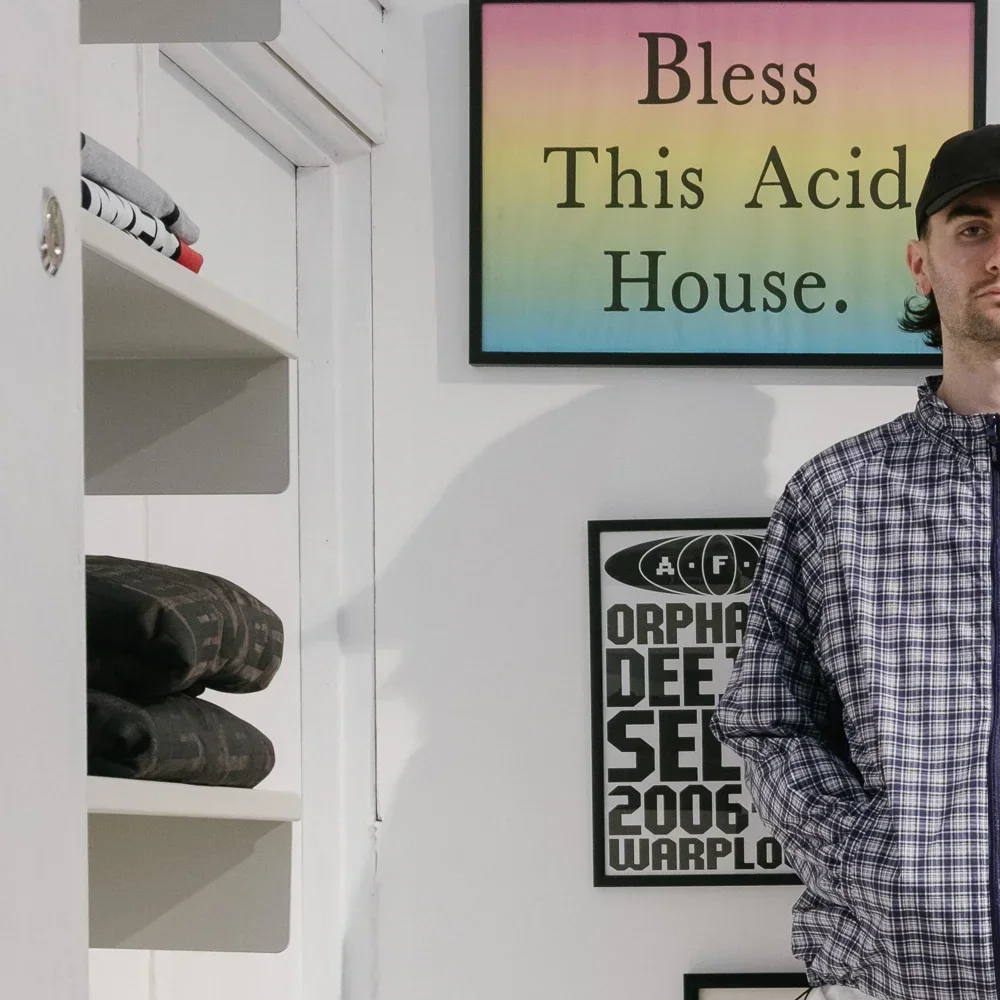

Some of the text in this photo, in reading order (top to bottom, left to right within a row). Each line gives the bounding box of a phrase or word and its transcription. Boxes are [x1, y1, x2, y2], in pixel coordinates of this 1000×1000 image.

[638, 32, 818, 105] Bless
[543, 144, 912, 210] This Acid
[604, 250, 848, 314] House.
[608, 784, 757, 835] 2006
[609, 837, 793, 871] WARPLO
